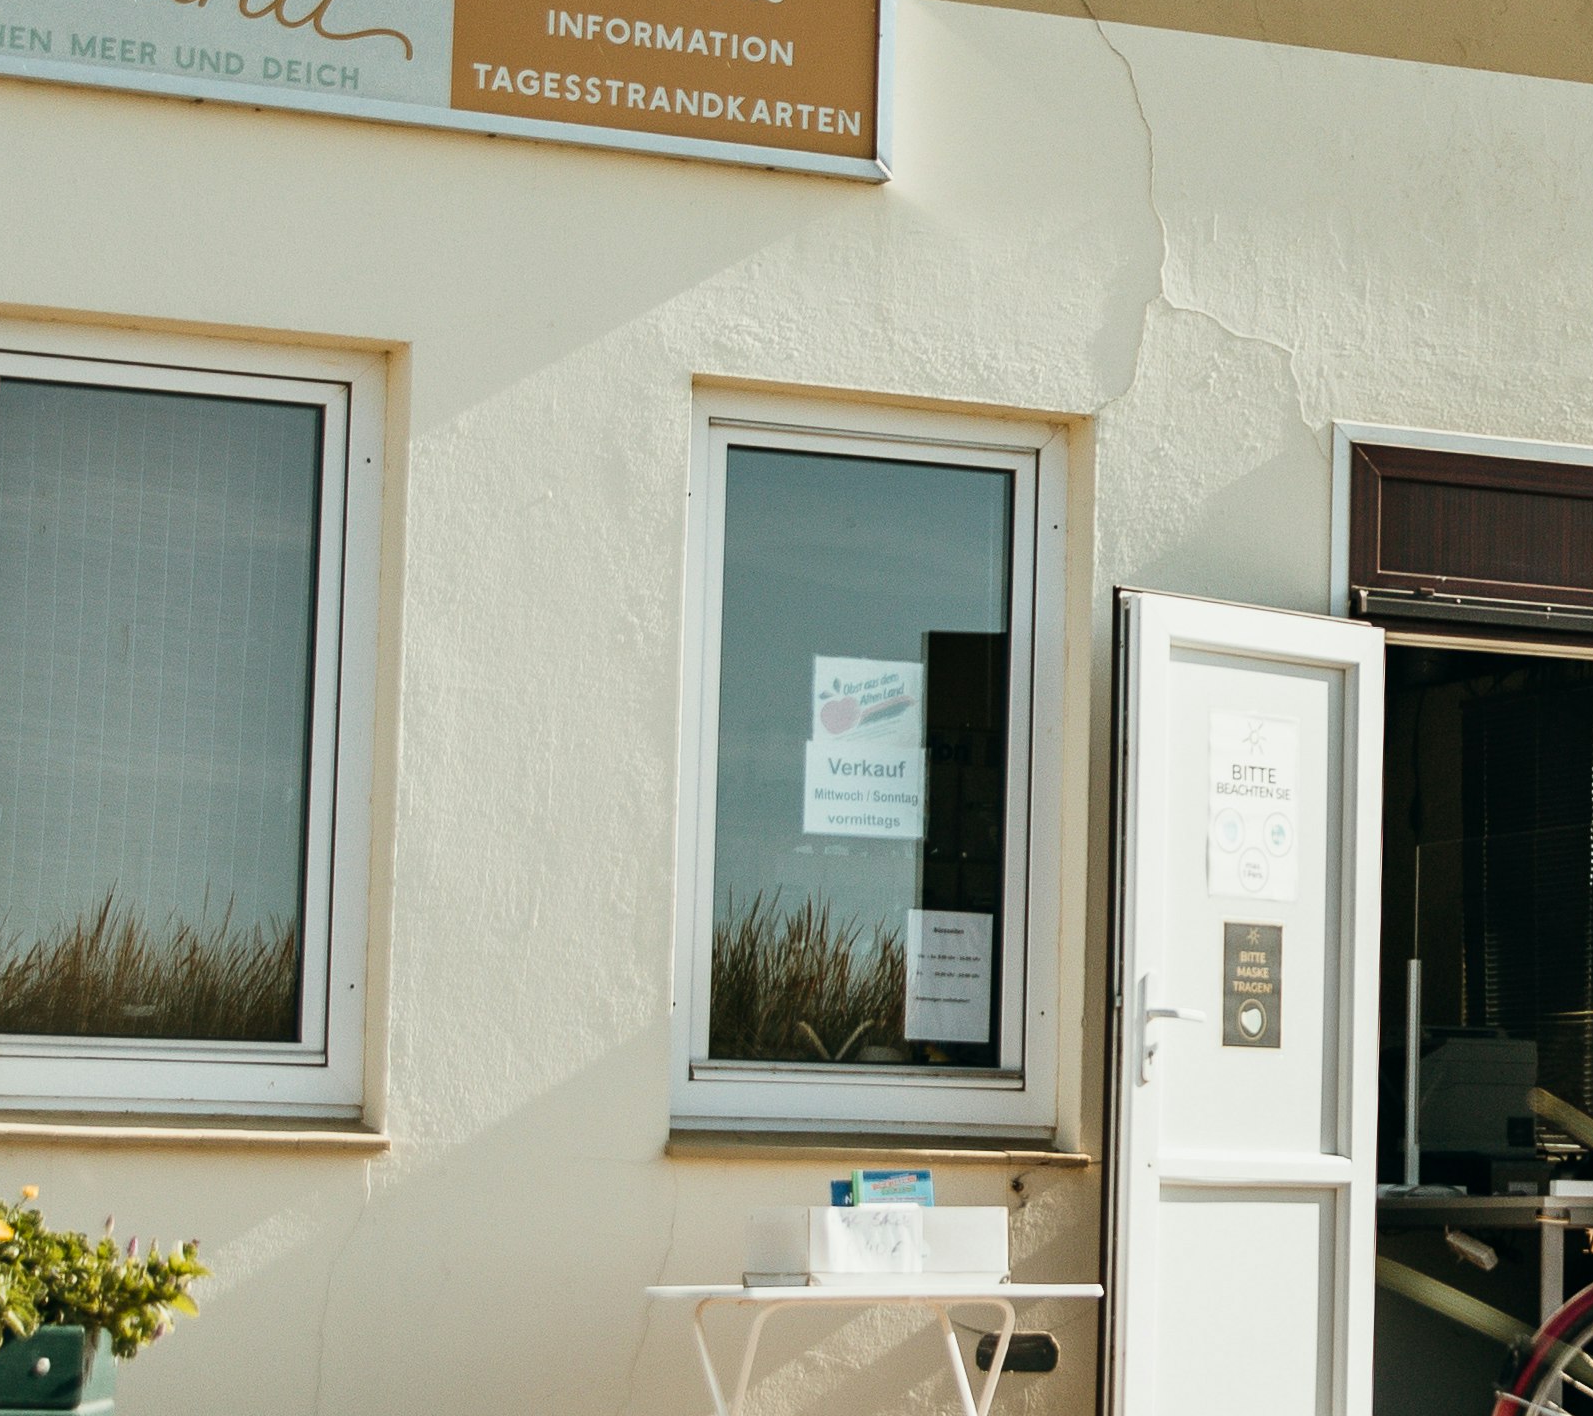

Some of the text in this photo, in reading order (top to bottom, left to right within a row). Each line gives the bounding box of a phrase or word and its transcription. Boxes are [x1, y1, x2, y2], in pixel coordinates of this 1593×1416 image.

[547, 8, 795, 67] INFORMATION
[70, 33, 157, 65] MEER
[175, 45, 245, 76] UND
[262, 56, 359, 90] DEICH
[473, 62, 863, 137] TAGESSTRANDKARTEN
[884, 682, 905, 699] Land
[828, 757, 907, 778] Verkauf
[1232, 764, 1277, 784] BITTE
[814, 788, 864, 801] Mittwoch
[873, 790, 919, 806] Sonntag
[1216, 782, 1292, 800] BEACHTEN SIE
[828, 813, 901, 829] vormittags
[1239, 951, 1266, 963] BITTE
[1237, 966, 1269, 978] MASKE
